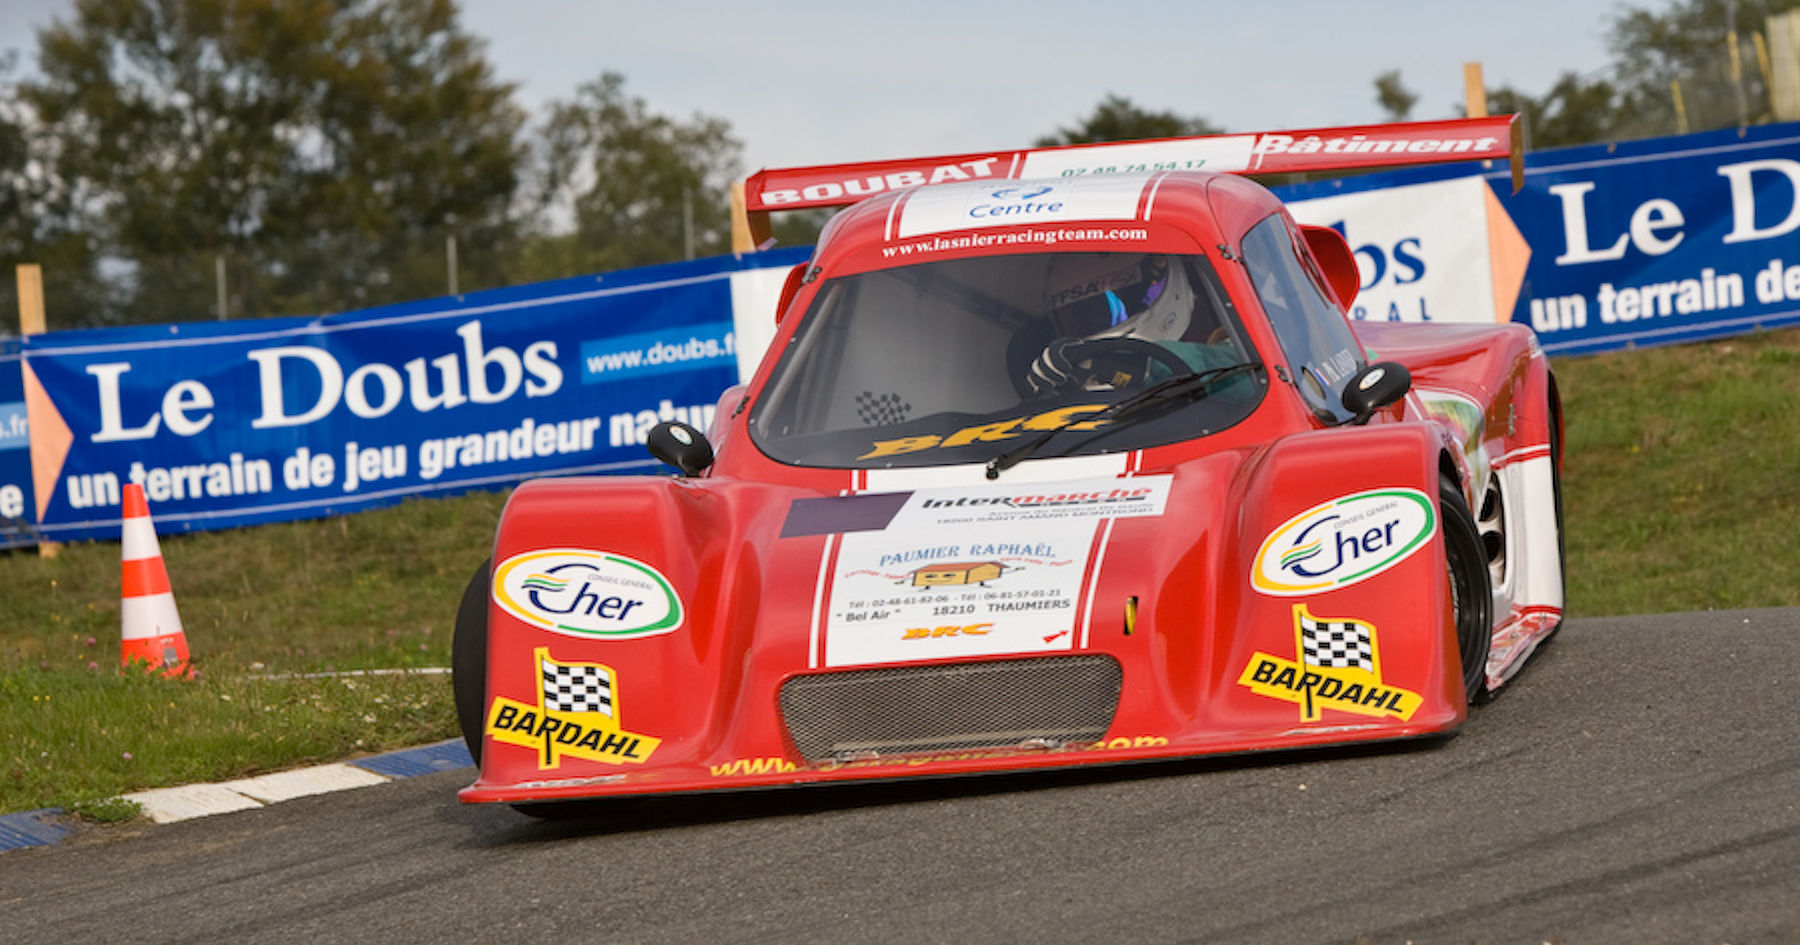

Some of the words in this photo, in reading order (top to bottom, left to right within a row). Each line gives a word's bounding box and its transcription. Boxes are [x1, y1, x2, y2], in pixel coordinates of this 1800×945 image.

[760, 157, 998, 206] BOUBAT
[1252, 133, 1498, 155] Bâtiment
[969, 199, 1064, 219] Centre
[1548, 181, 1685, 267] Le
[882, 228, 1147, 258] www.lasnierracingteam.com
[1530, 294, 1587, 333] un
[1597, 268, 1745, 324] terrain
[1755, 258, 1800, 305] de
[86, 361, 214, 442] Le
[248, 320, 563, 429] Doubs
[856, 403, 1116, 461] BRC
[67, 471, 120, 509] un
[129, 453, 272, 502] terrain
[283, 447, 335, 490] de
[342, 442, 407, 492] jeu
[419, 416, 600, 480] grandeur
[879, 545, 960, 566] PAUMIER
[970, 541, 1056, 559] RAPHAËL
[1281, 514, 1400, 577] Cher
[522, 563, 644, 621] Cher
[846, 612, 867, 622] Bel
[870, 609, 891, 620] Air
[933, 603, 975, 616] 18210
[988, 599, 1071, 613] THAUMIERS
[901, 622, 996, 641] BRC
[1252, 659, 1403, 713] BARDAHL
[493, 704, 642, 760] BARDAHL
